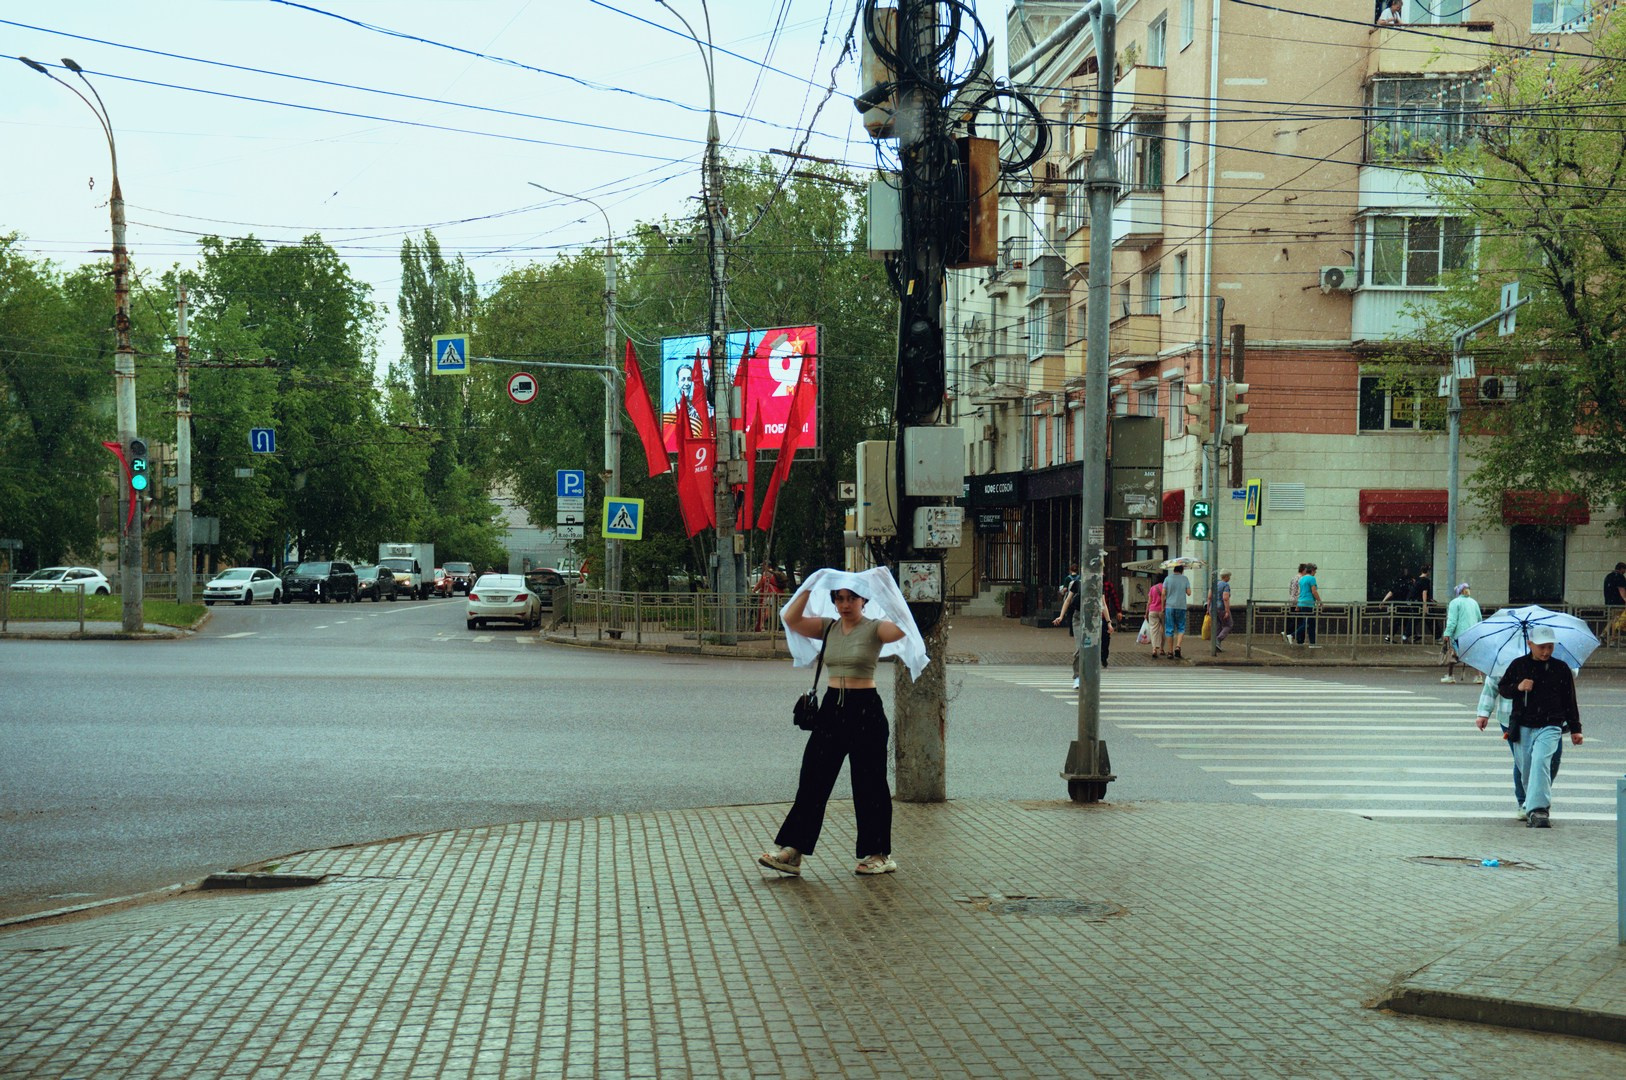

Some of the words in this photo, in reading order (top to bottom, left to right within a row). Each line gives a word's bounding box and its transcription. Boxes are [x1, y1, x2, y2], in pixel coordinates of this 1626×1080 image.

[768, 337, 803, 397] 9
[133, 459, 146, 471] 24
[694, 447, 707, 467] 9
[564, 473, 580, 494] P
[984, 484, 996, 494] КОФЕ
[1194, 503, 1208, 516] 24
